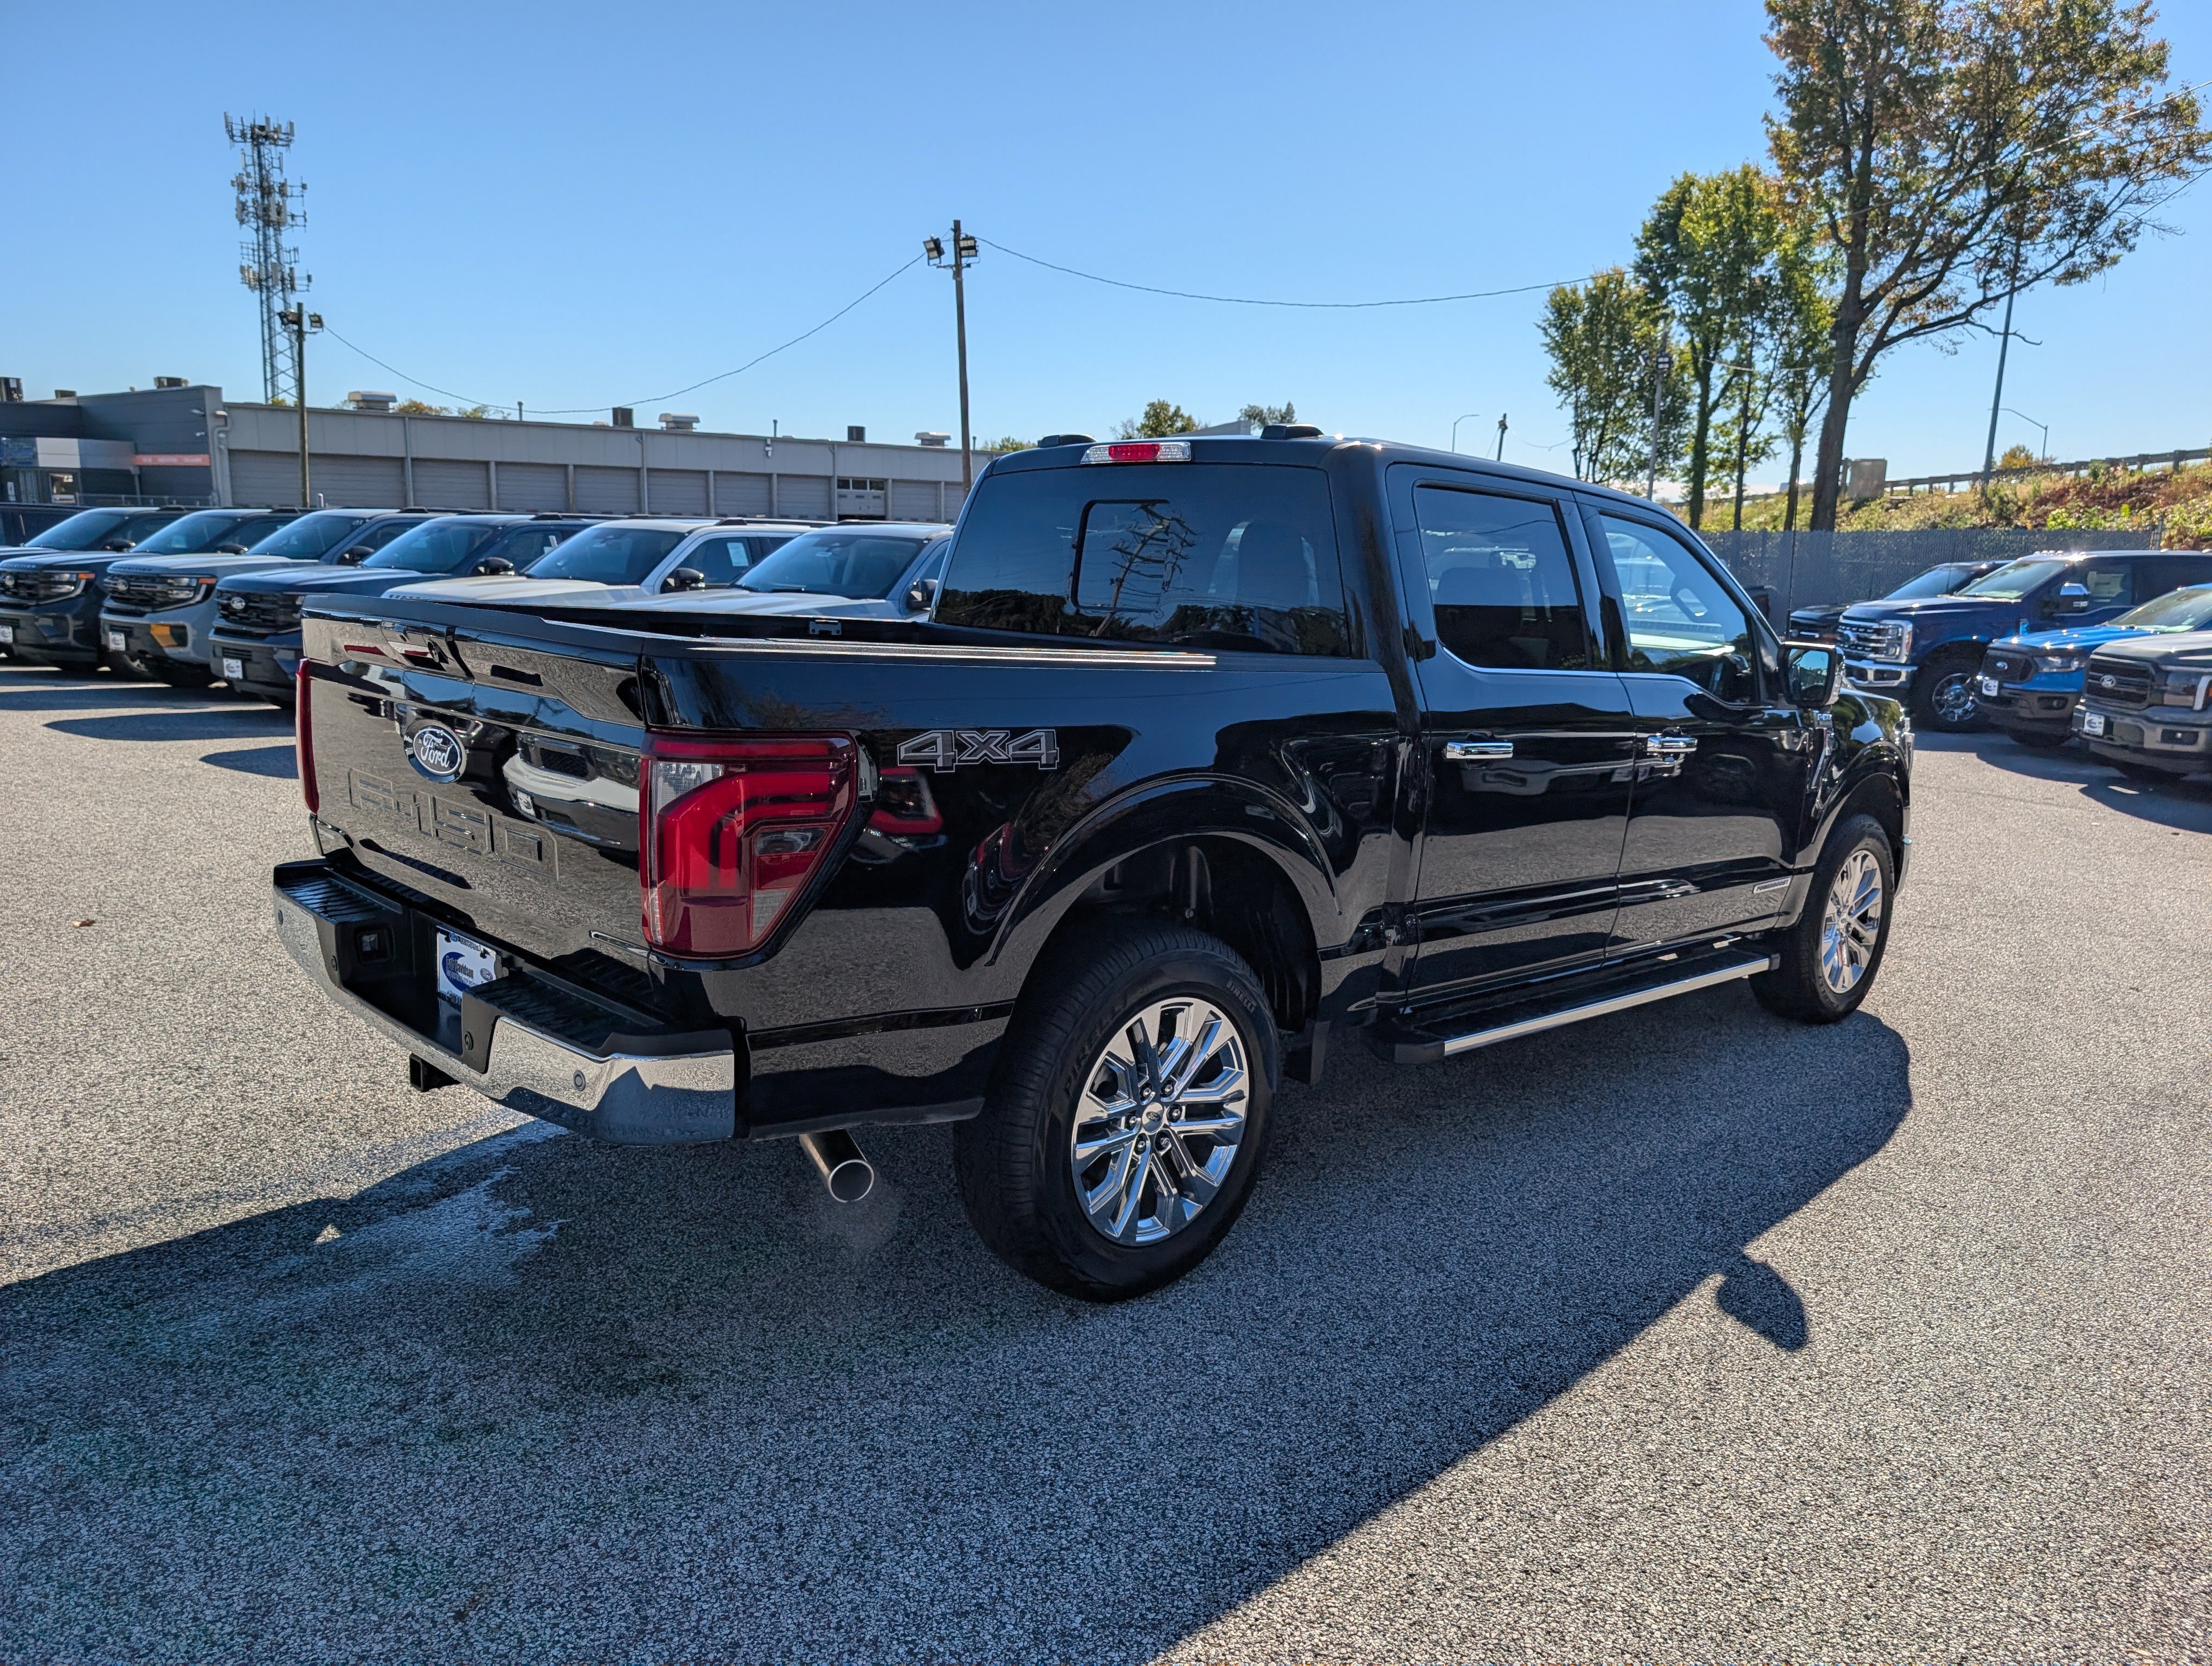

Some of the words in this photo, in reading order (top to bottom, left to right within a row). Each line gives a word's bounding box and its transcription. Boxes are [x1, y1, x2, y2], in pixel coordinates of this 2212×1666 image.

[420, 733, 454, 768] Ford
[348, 767, 559, 882] F-150
[1226, 978, 1256, 1013] PIRELLI
